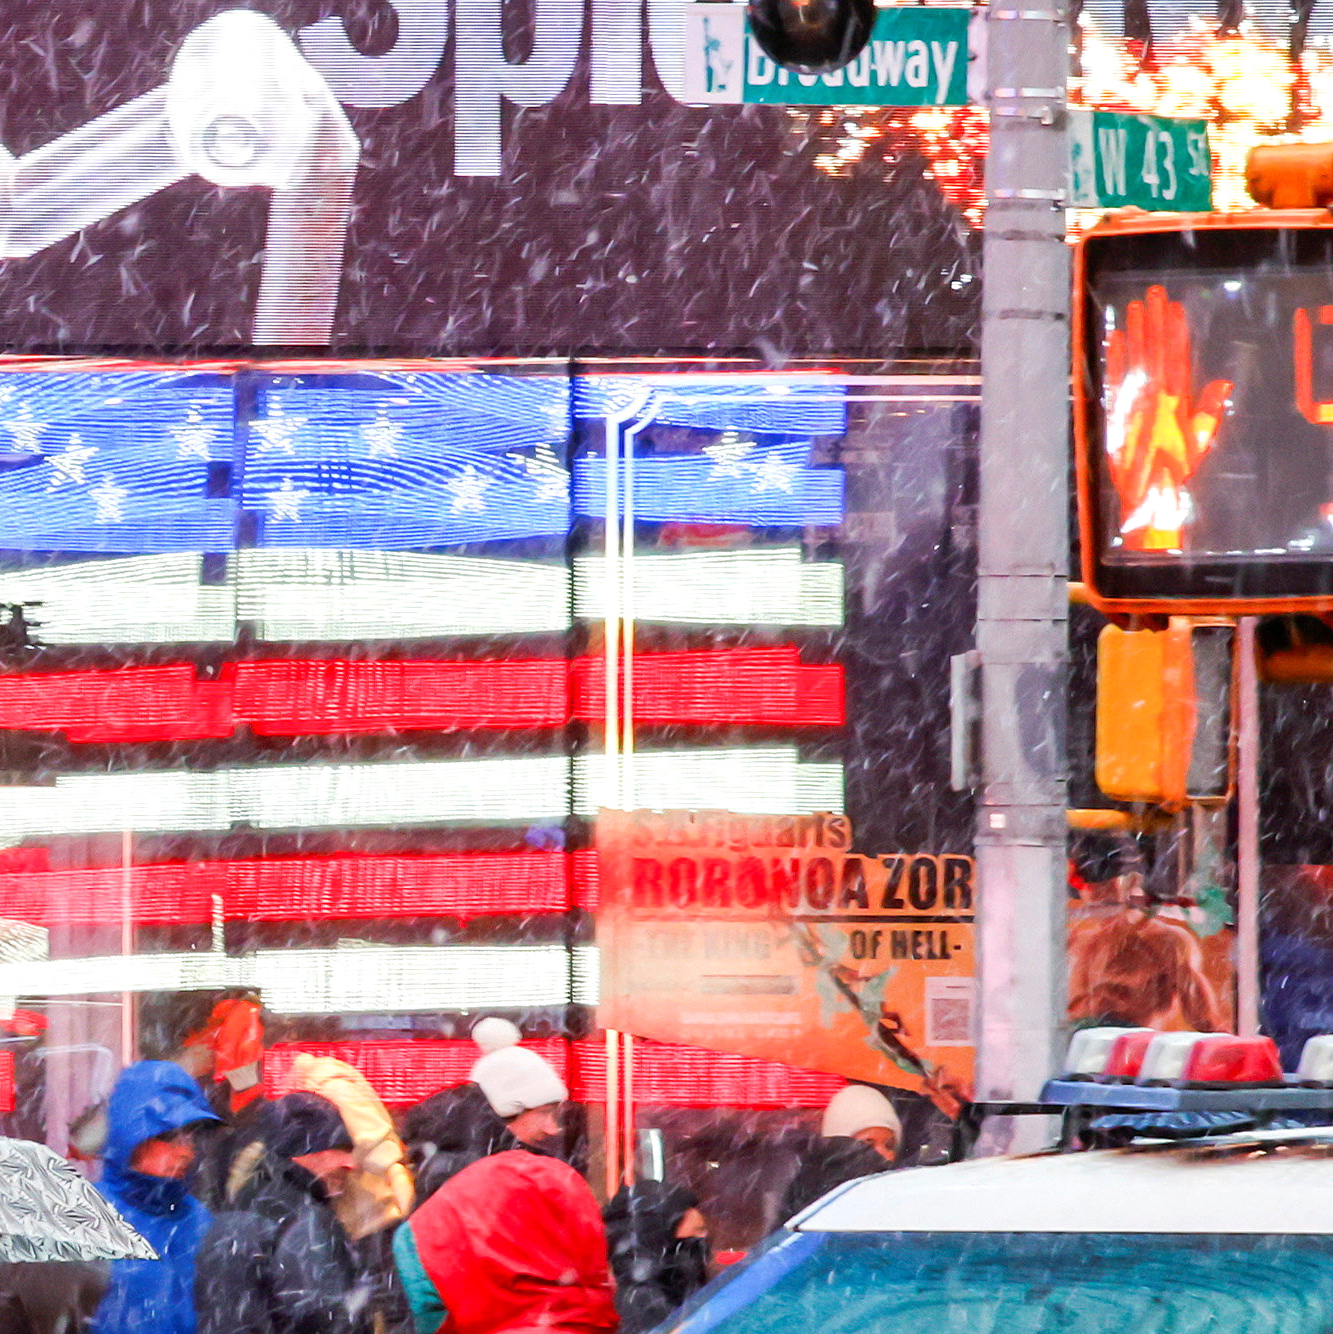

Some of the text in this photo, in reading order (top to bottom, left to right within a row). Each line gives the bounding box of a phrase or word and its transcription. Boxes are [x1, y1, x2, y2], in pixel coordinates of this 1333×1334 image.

[1098, 128, 1127, 196] W
[1141, 130, 1177, 200] 43
[850, 929, 882, 959] OF
